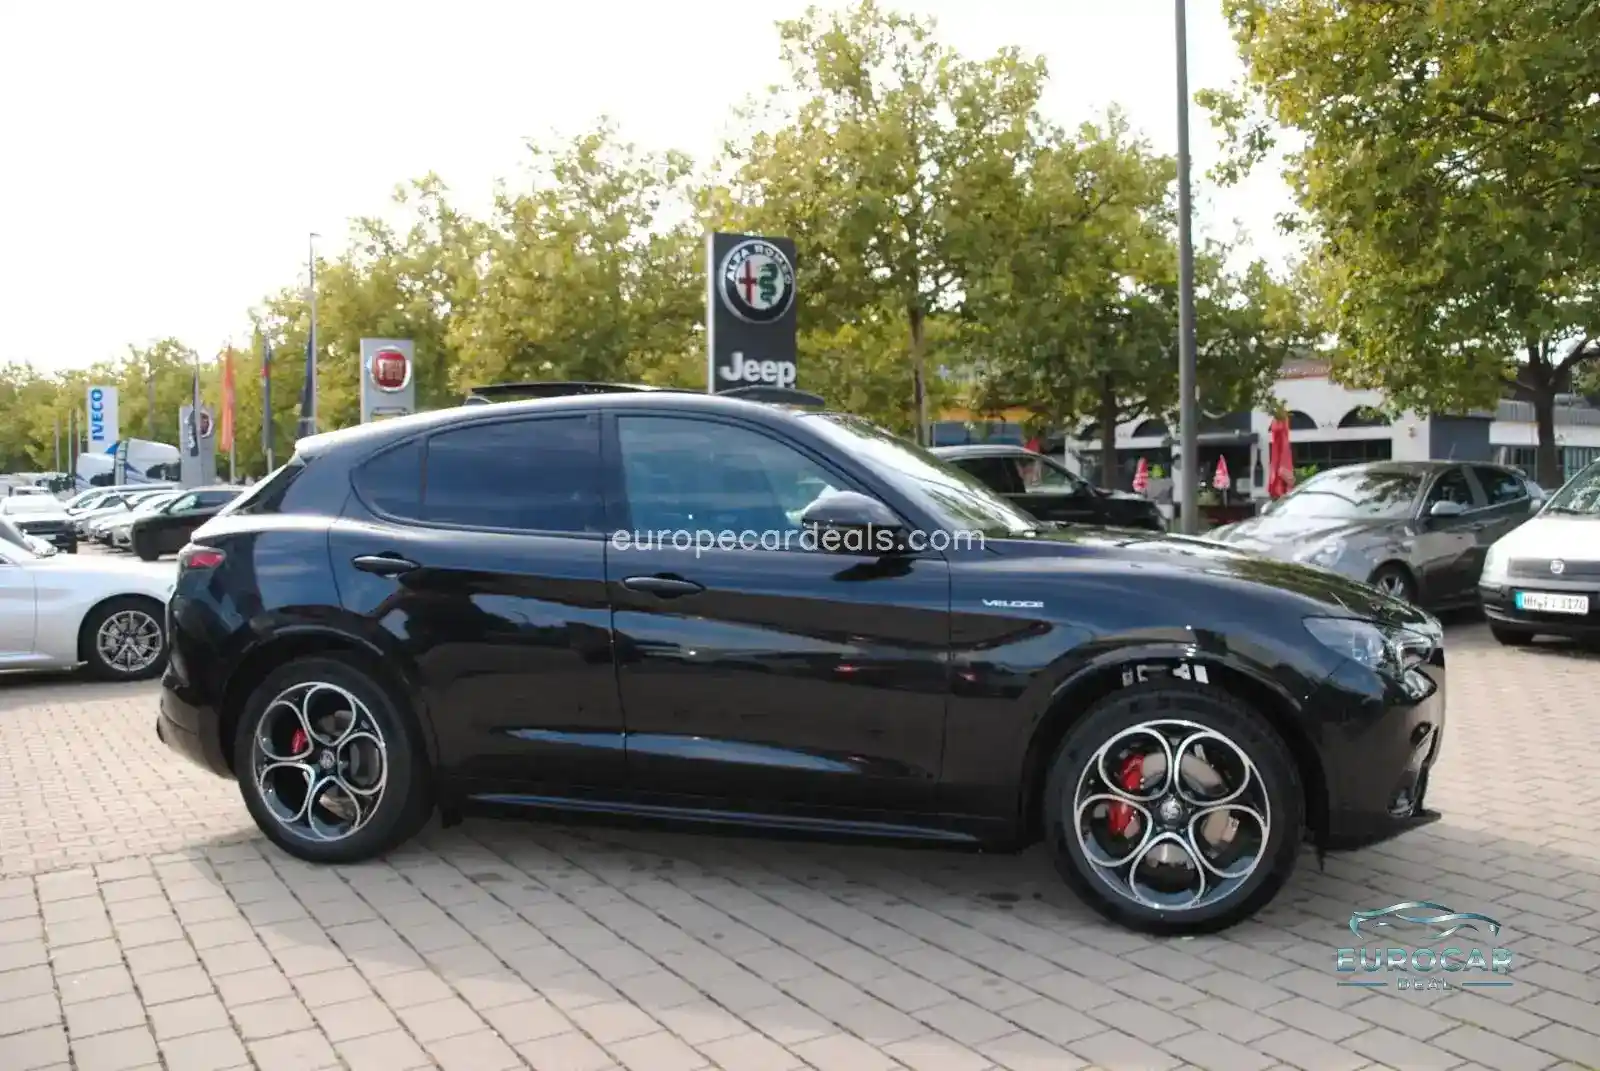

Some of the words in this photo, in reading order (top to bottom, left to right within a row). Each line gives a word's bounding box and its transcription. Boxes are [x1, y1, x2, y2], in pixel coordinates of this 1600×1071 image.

[725, 247, 750, 282] ALFA
[754, 244, 793, 285] ROMEO
[719, 351, 797, 388] Jeep
[91, 388, 104, 440] IVECO
[981, 598, 1044, 608] VELOCE
